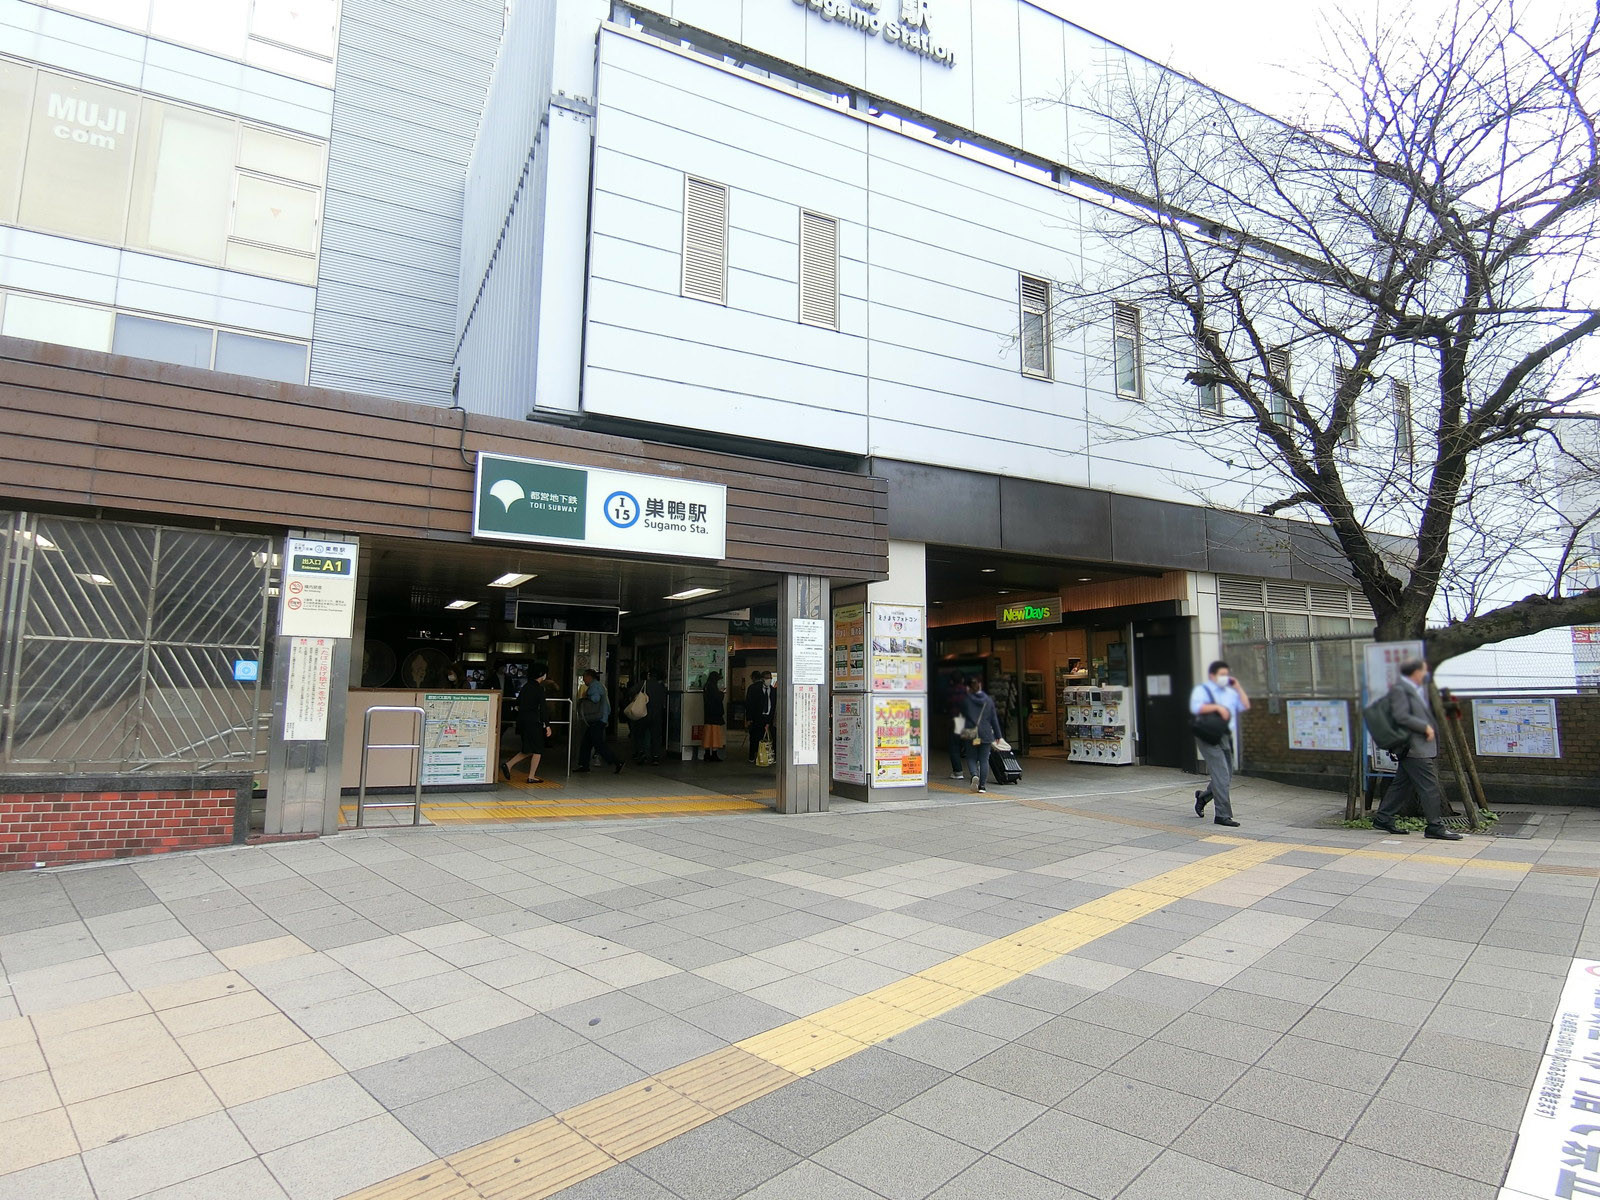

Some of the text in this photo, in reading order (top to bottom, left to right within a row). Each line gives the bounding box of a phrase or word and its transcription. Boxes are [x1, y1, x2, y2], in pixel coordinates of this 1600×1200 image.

[884, 21, 957, 66] Station
[48, 93, 127, 135] MUJI
[54, 125, 116, 150] com
[530, 491, 578, 505] 都営地下鉄
[619, 498, 625, 507] I
[530, 502, 578, 513] TOEI SUBWAY
[615, 508, 630, 521] 15
[645, 497, 707, 523] 巣鴨駅
[644, 518, 709, 535] Sugamo Sta.
[322, 560, 342, 572] A1
[1003, 606, 1051, 621] NewDays
